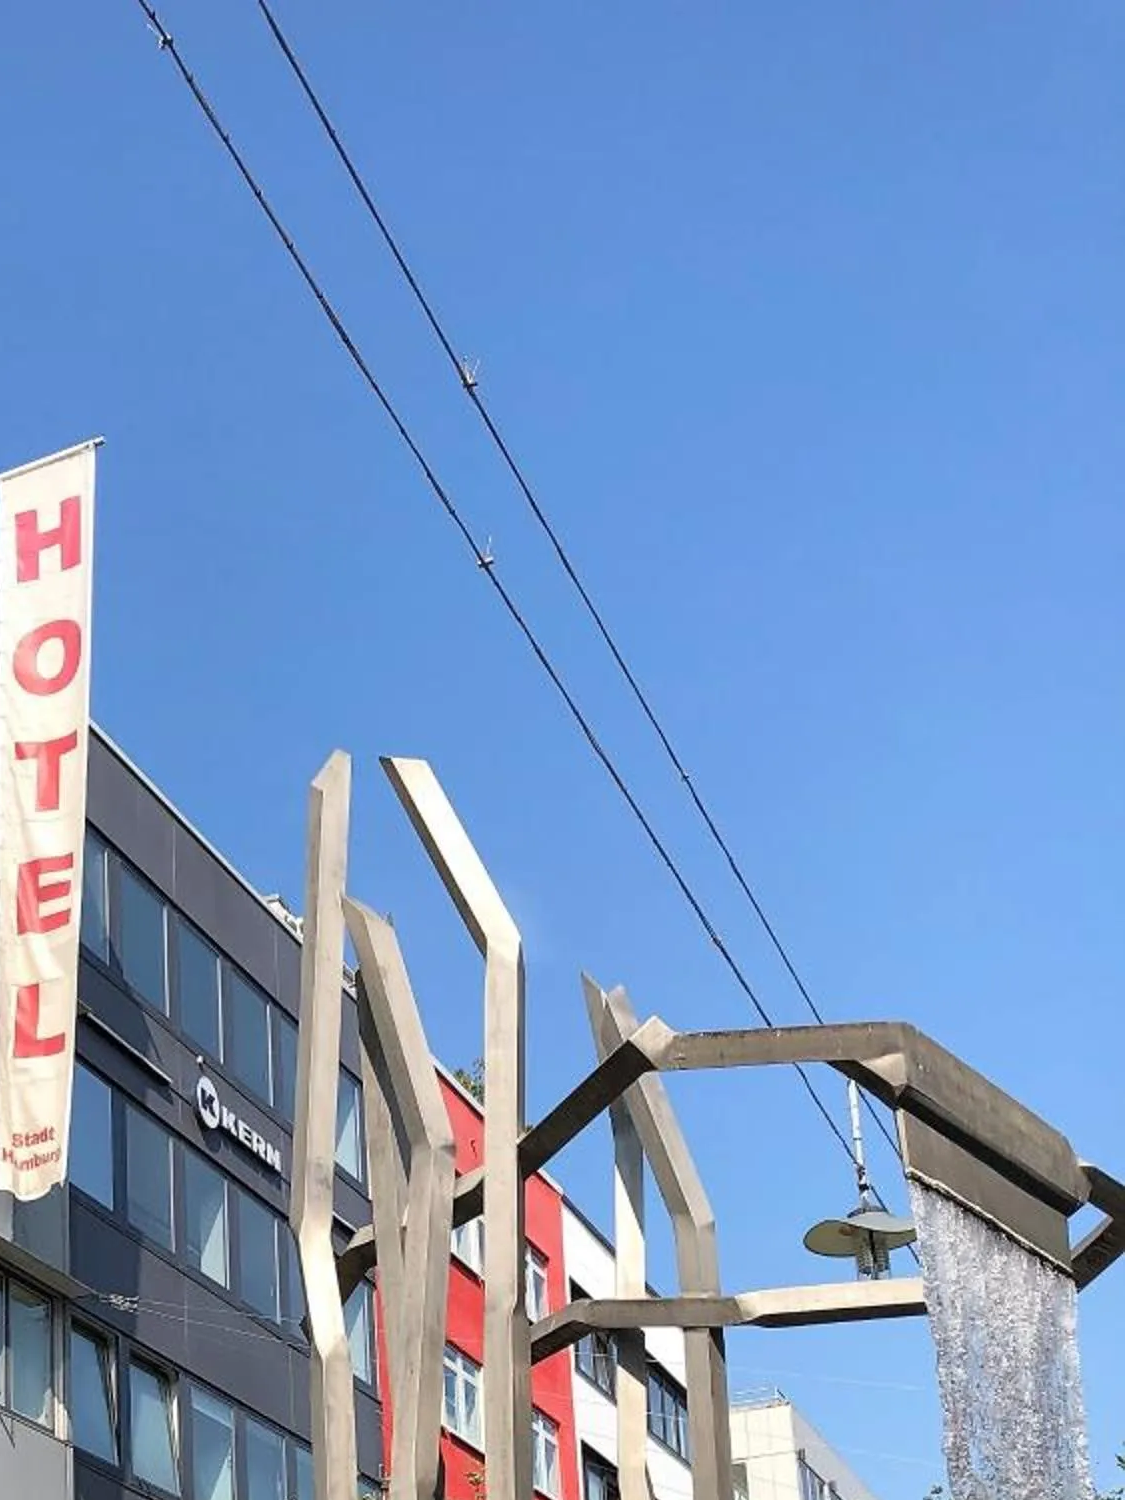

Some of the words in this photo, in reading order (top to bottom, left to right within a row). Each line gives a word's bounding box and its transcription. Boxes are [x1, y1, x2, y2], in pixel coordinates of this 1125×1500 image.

[12, 495, 81, 1059] HOTEL
[11, 1126, 55, 1148] Stadt
[221, 1105, 282, 1172] KERN
